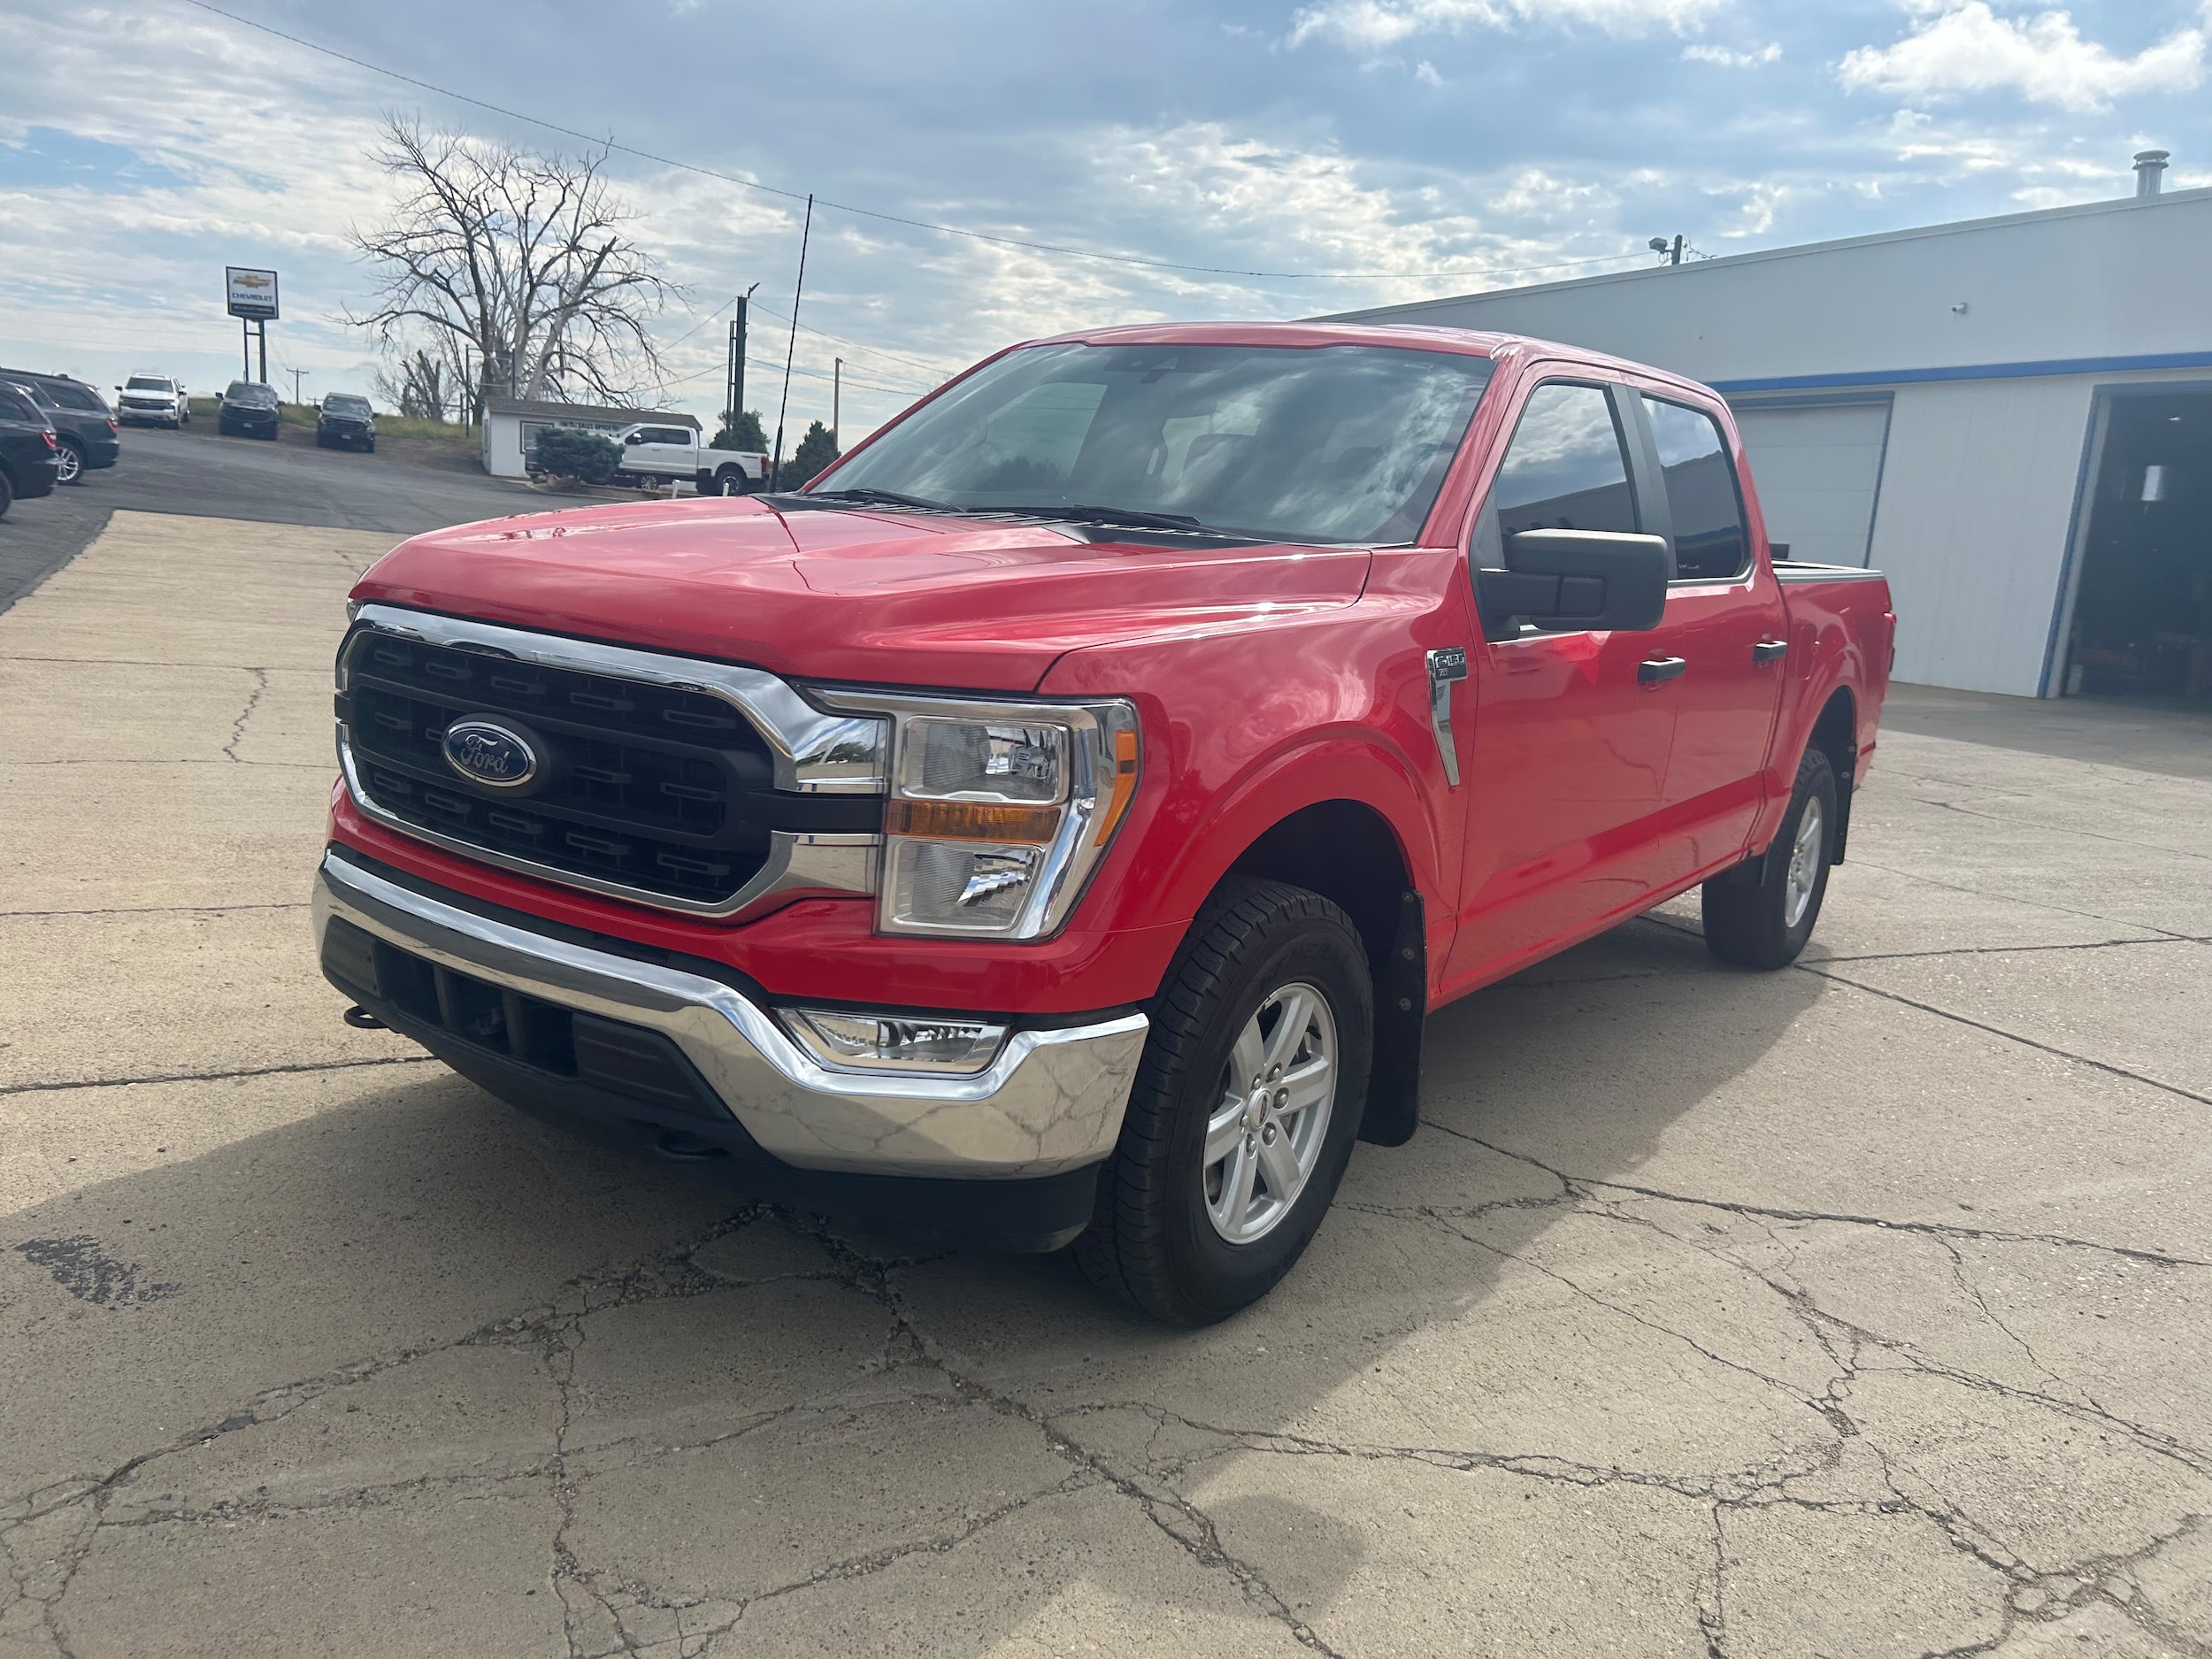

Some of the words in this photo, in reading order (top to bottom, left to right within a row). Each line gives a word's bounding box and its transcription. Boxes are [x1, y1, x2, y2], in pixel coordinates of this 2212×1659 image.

[232, 292, 273, 302] CHEVROLET
[1435, 654, 1466, 669] F-150
[460, 733, 511, 773] Ford
